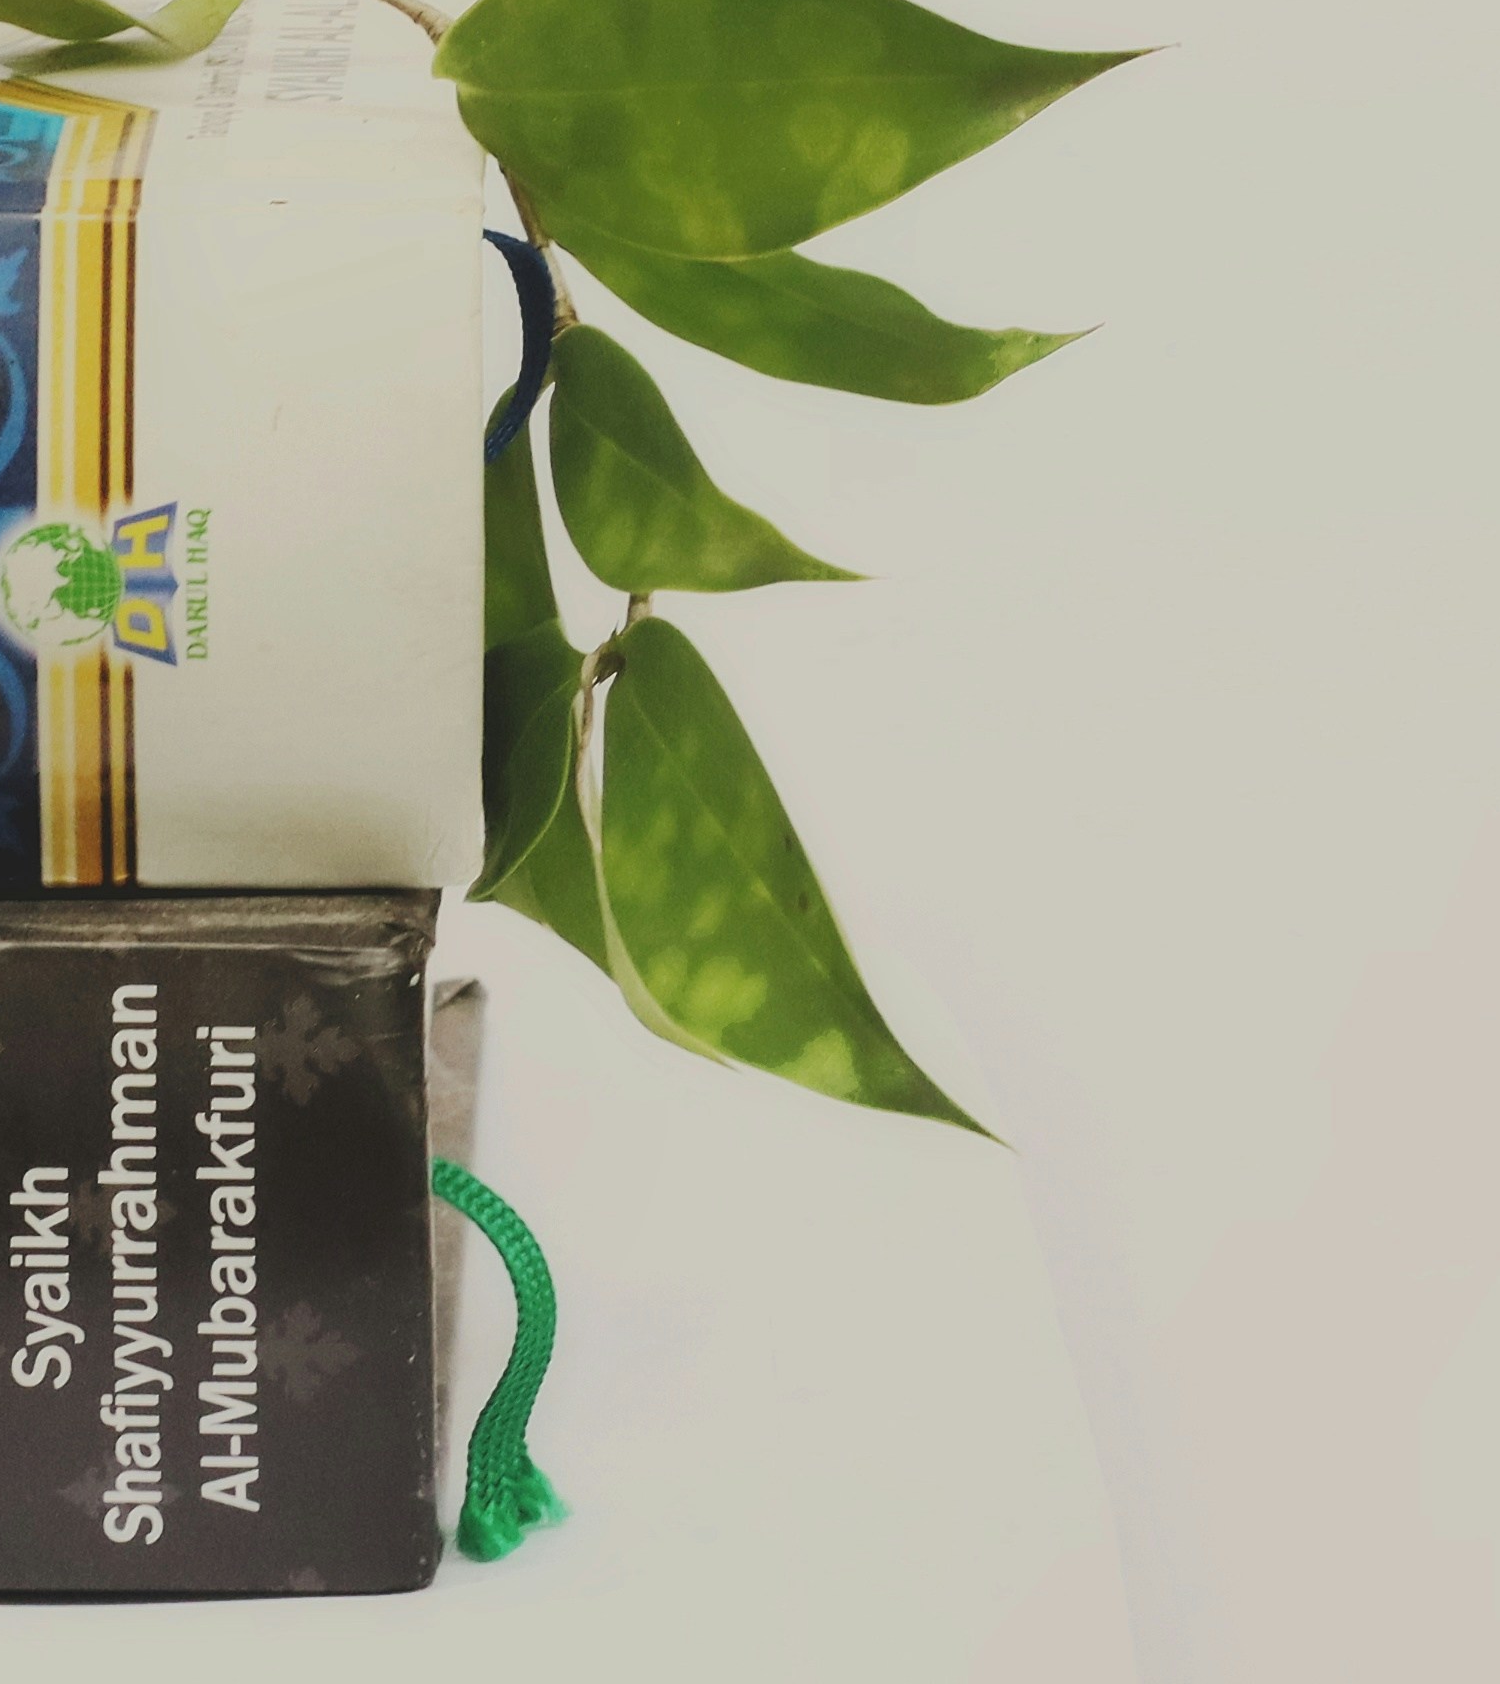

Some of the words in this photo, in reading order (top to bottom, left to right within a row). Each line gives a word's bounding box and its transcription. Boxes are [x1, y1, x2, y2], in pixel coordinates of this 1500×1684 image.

[186, 508, 213, 564] HAQ
[186, 573, 209, 660] DARUL
[10, 1166, 85, 1390] Syaikh
[98, 983, 174, 1546] Shafiyyurrahman
[195, 1025, 261, 1513] Al-Mubarakfuri
